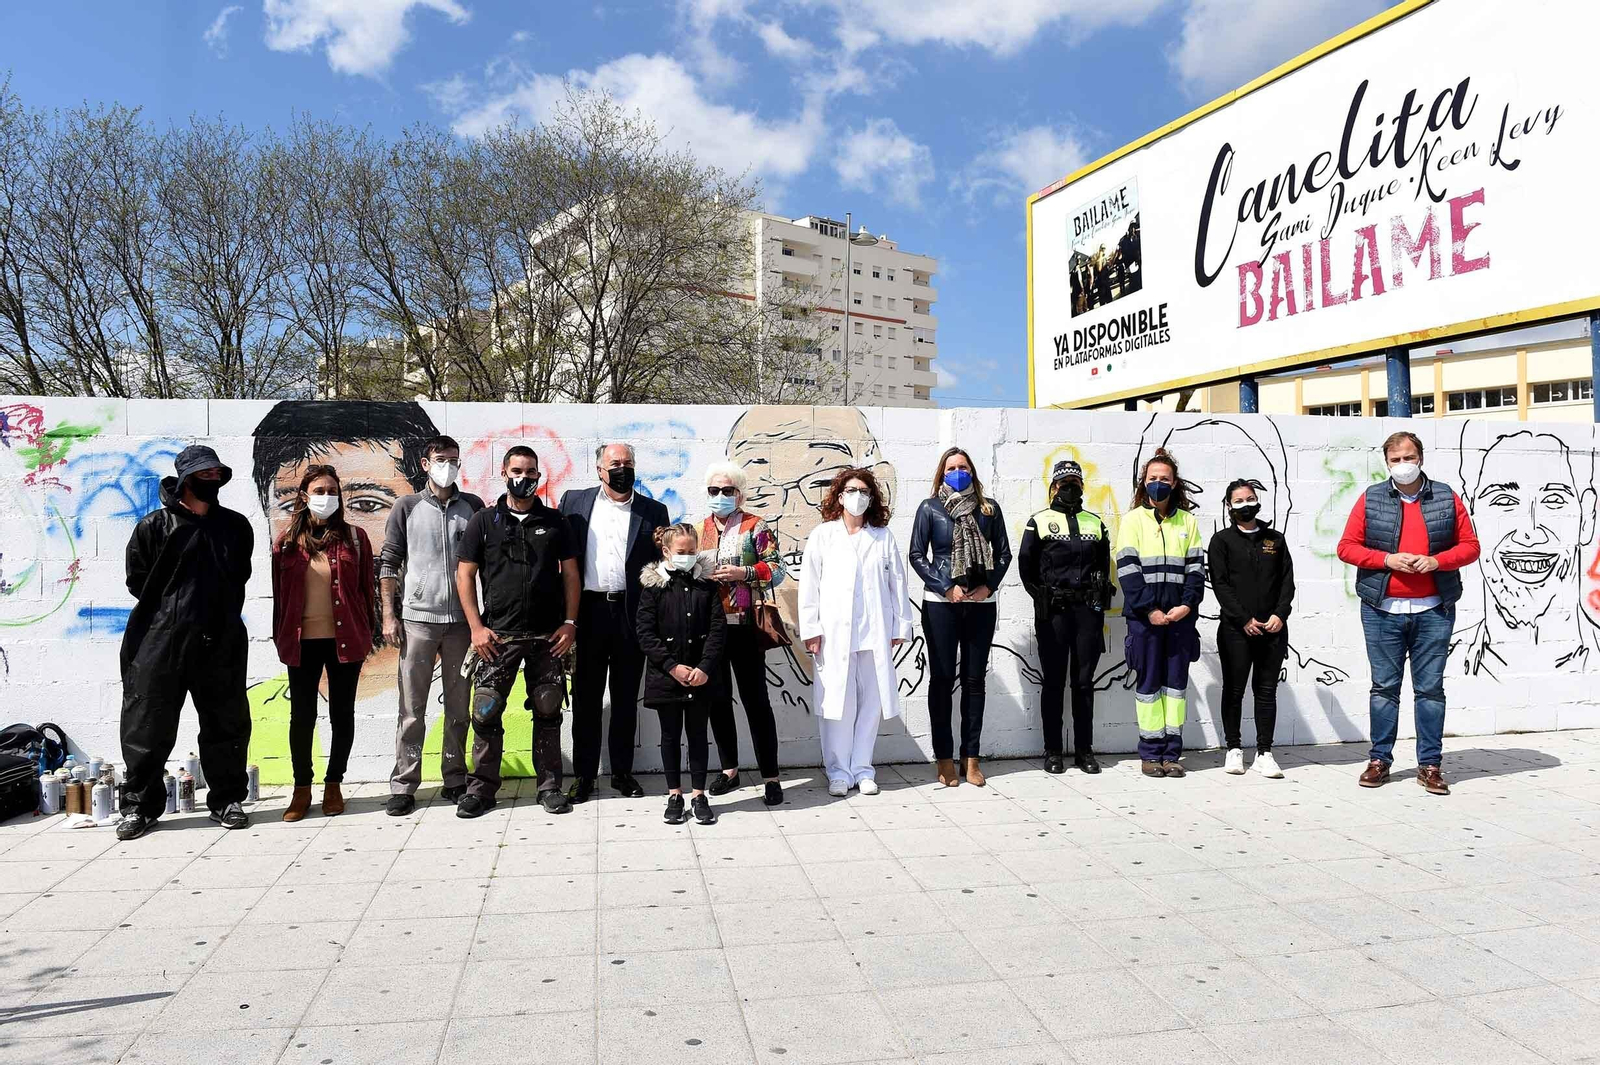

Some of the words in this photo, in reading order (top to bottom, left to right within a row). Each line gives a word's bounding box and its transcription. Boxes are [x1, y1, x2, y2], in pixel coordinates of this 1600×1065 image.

[1073, 186, 1129, 237] BAILAME
[1195, 77, 1478, 287] Canelita
[1257, 212, 1313, 268] Sami
[1320, 179, 1401, 240] Duque
[1414, 136, 1480, 203] Keen
[1489, 102, 1564, 171] Levy
[1235, 187, 1490, 328] BAILAME
[1053, 333, 1069, 356] YA
[1073, 302, 1168, 352] DISPONIBLE
[1053, 357, 1063, 370] EN
[1065, 341, 1122, 367] PLATAFORMAS
[1125, 328, 1171, 353] DIGITALES
